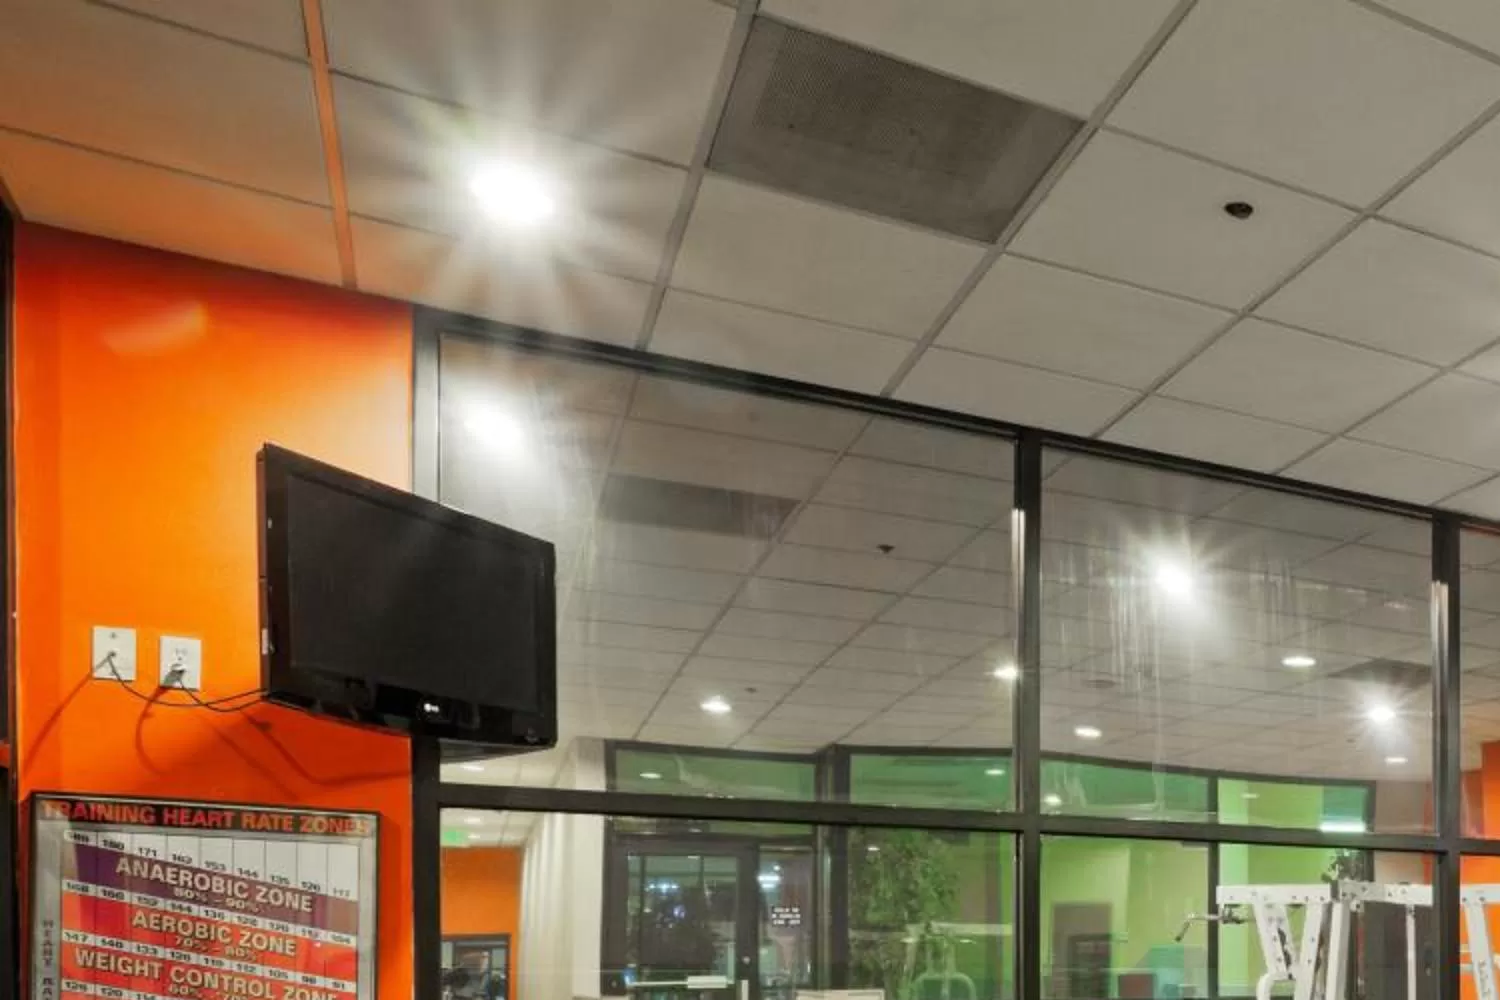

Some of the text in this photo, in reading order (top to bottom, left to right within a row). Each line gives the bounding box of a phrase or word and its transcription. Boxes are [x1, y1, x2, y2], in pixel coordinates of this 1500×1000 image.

[41, 800, 369, 834] TRAINING HEART RATE ZONES
[139, 847, 157, 857] 171
[115, 856, 313, 912] ANAEROBIC ZONE
[64, 931, 88, 943] 147
[132, 909, 297, 956] AEROBIC ZONE
[76, 947, 164, 979] WEIGHT
[169, 965, 276, 1000] CONTROL
